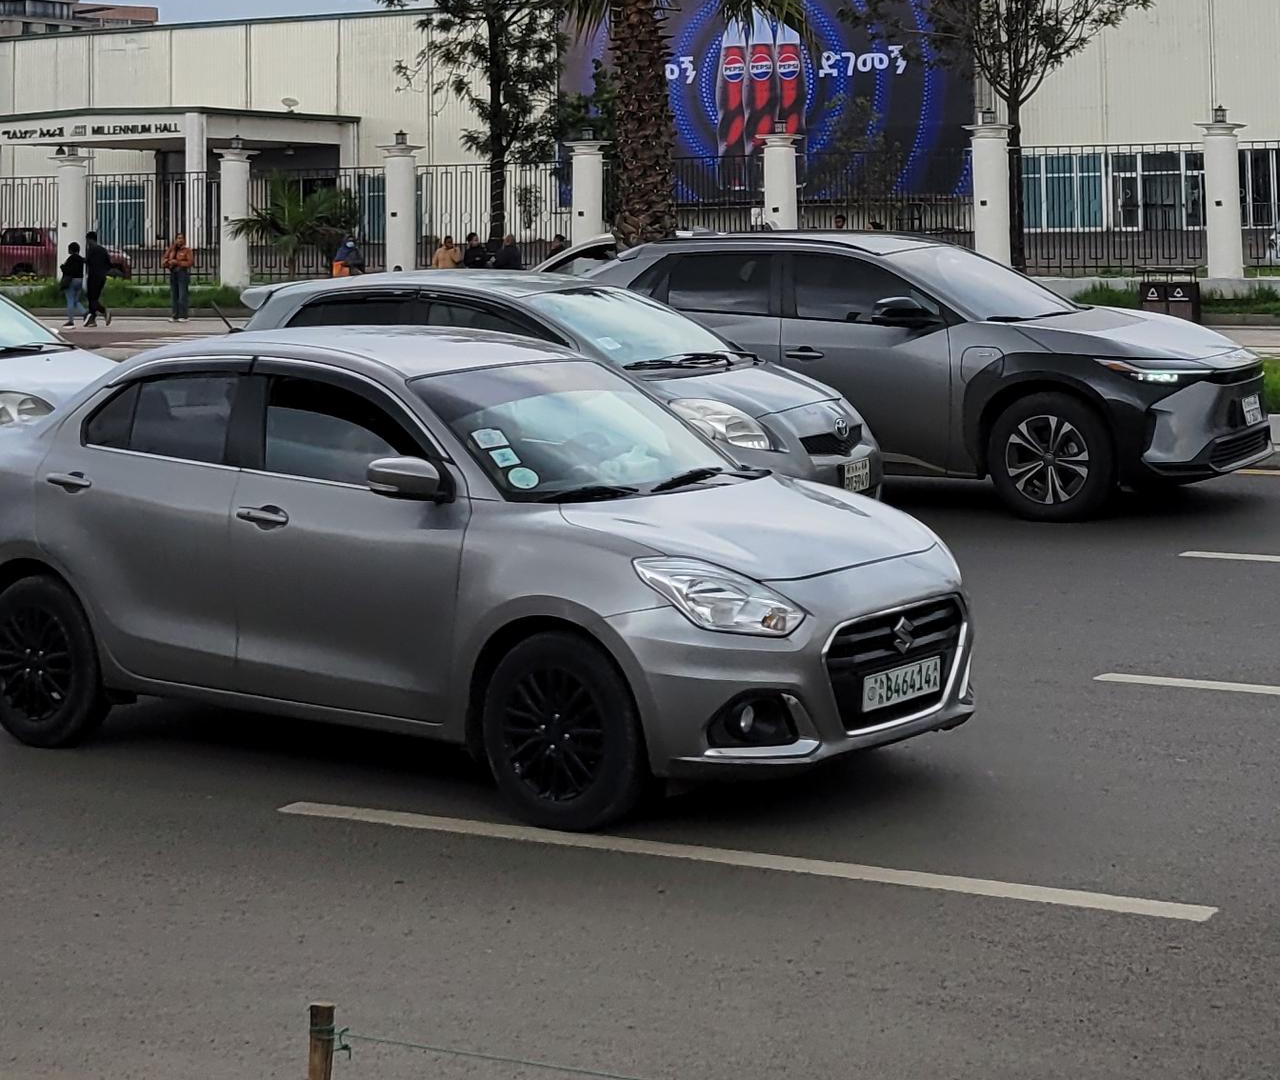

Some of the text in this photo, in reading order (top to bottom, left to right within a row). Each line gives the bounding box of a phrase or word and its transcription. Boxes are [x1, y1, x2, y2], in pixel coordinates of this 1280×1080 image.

[751, 63, 772, 71] PEPSI
[91, 123, 181, 136] MILLENNIUM HALL
[885, 663, 931, 702] B46414
